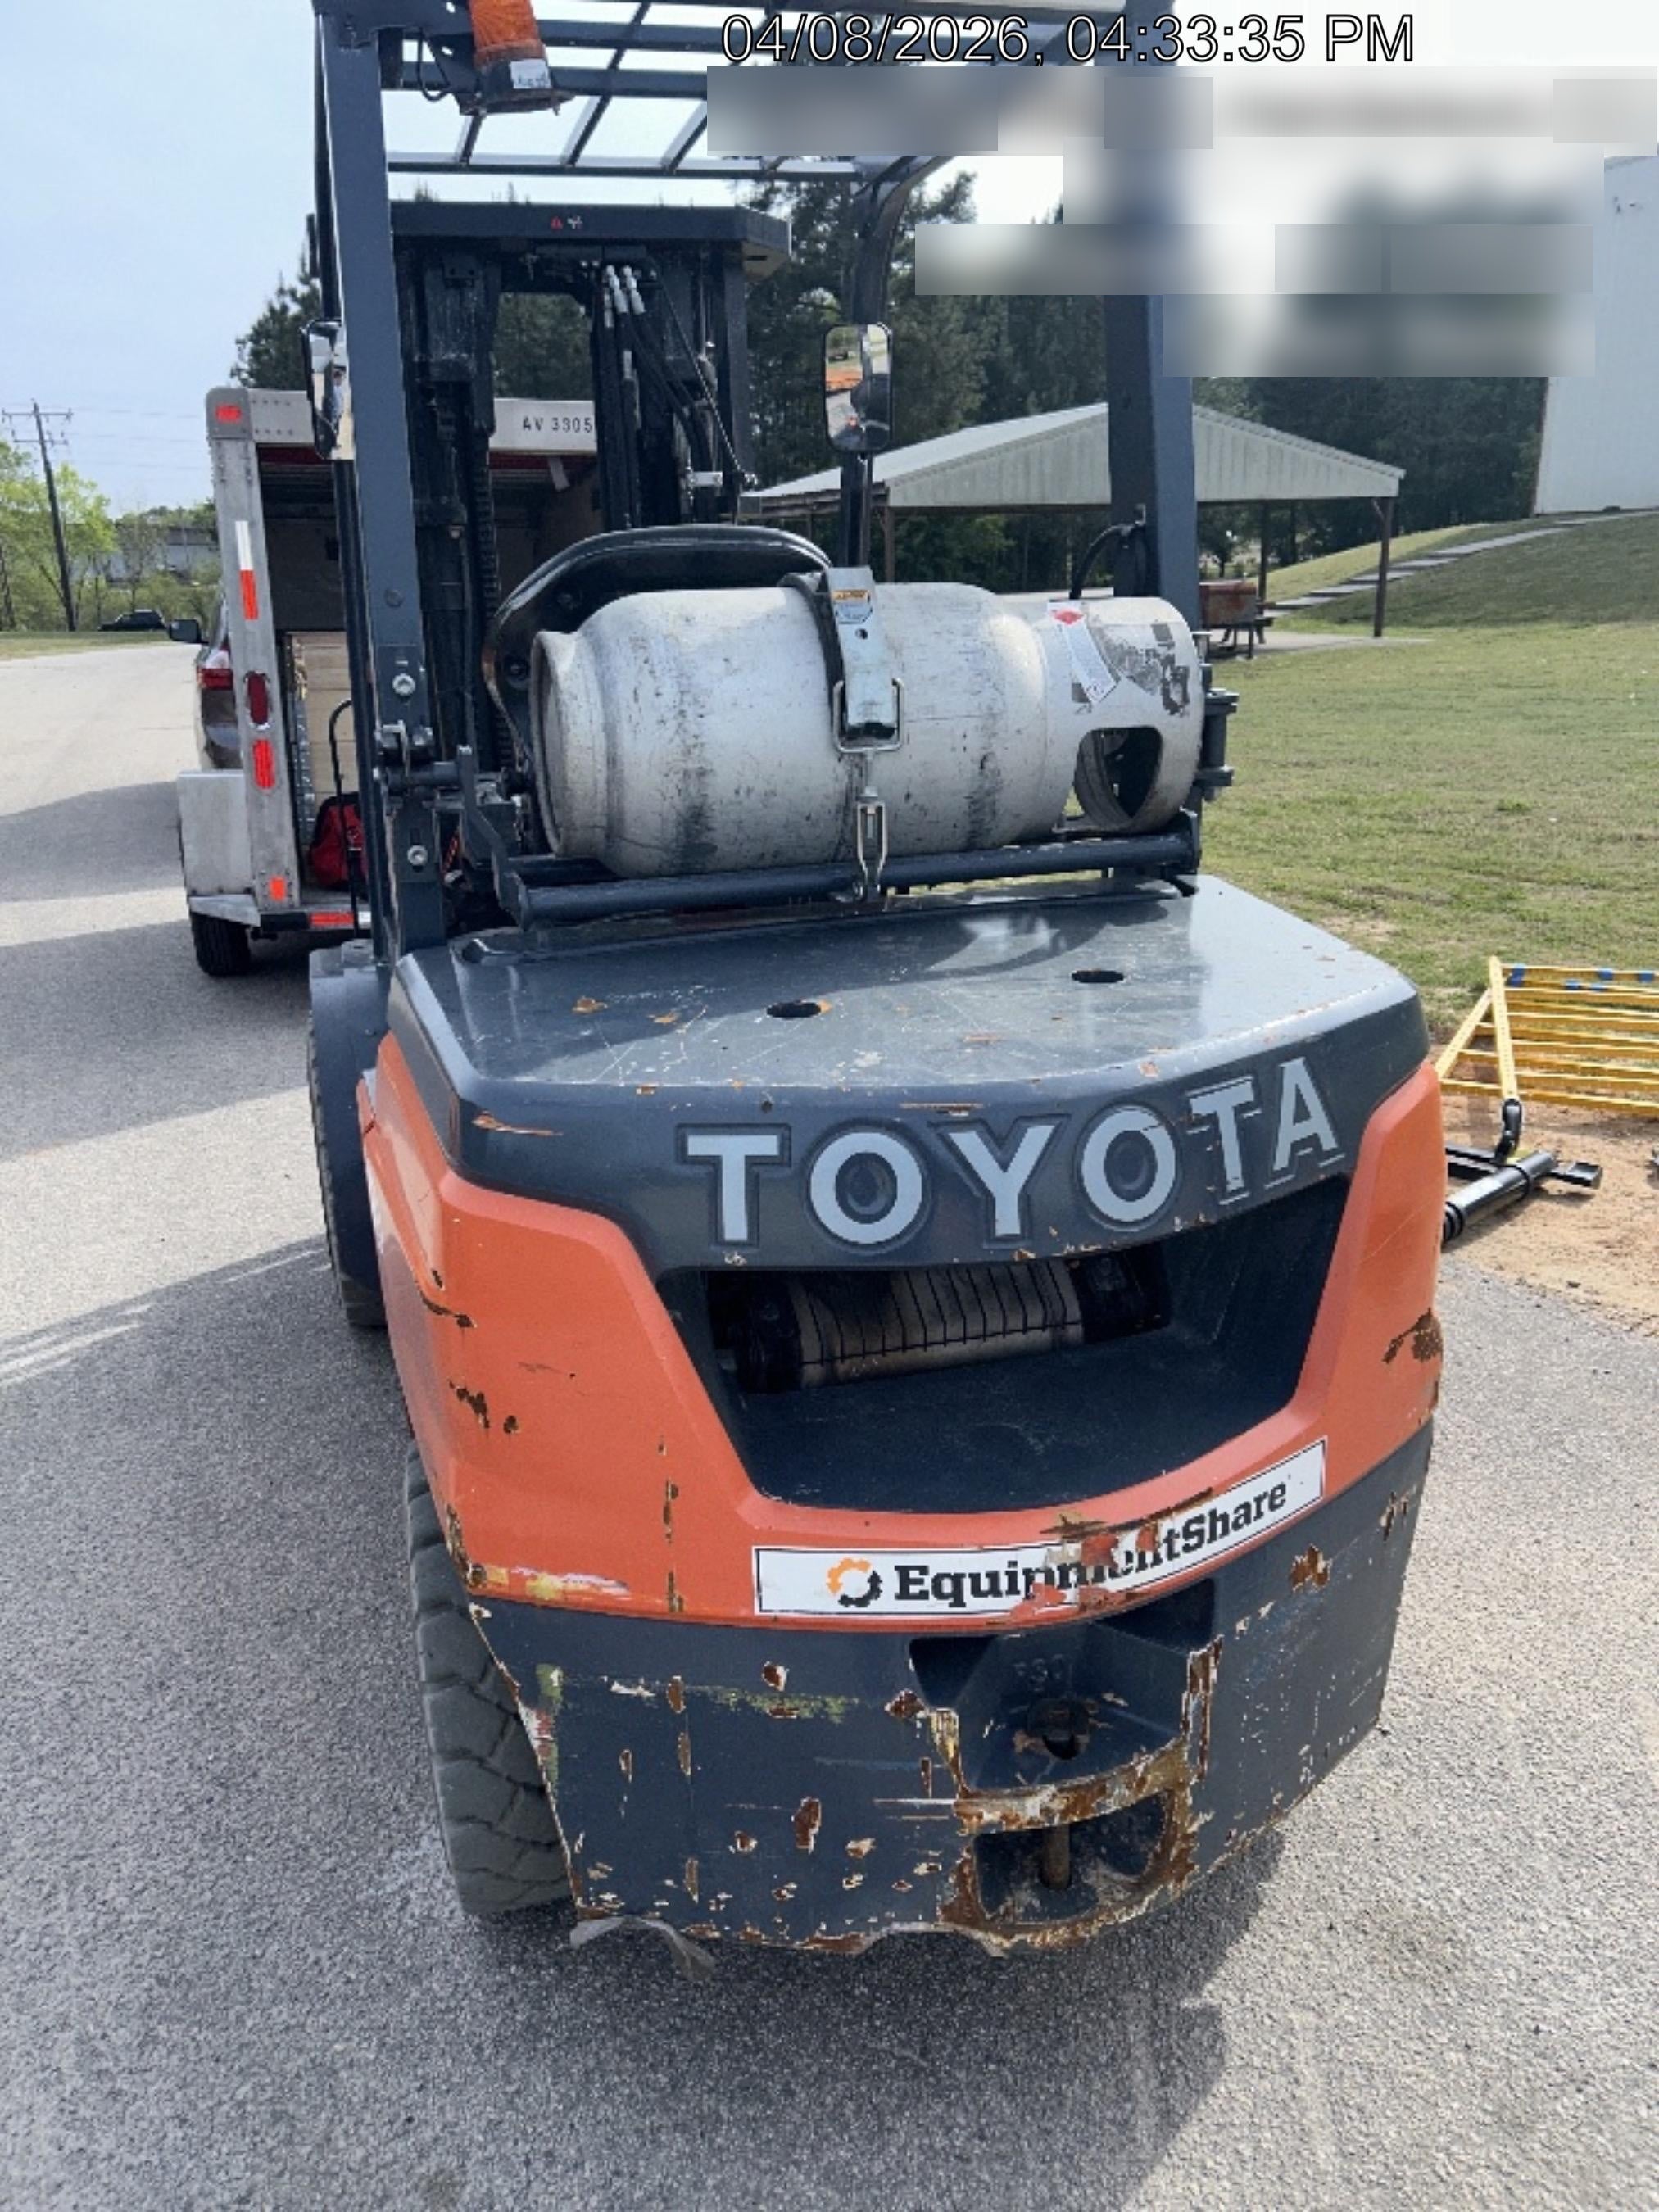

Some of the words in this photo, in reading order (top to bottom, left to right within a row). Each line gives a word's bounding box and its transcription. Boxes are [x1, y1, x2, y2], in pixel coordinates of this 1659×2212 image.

[523, 416, 543, 432] AV
[551, 417, 593, 433] 3305
[685, 1056, 1344, 1246] TOYOTA
